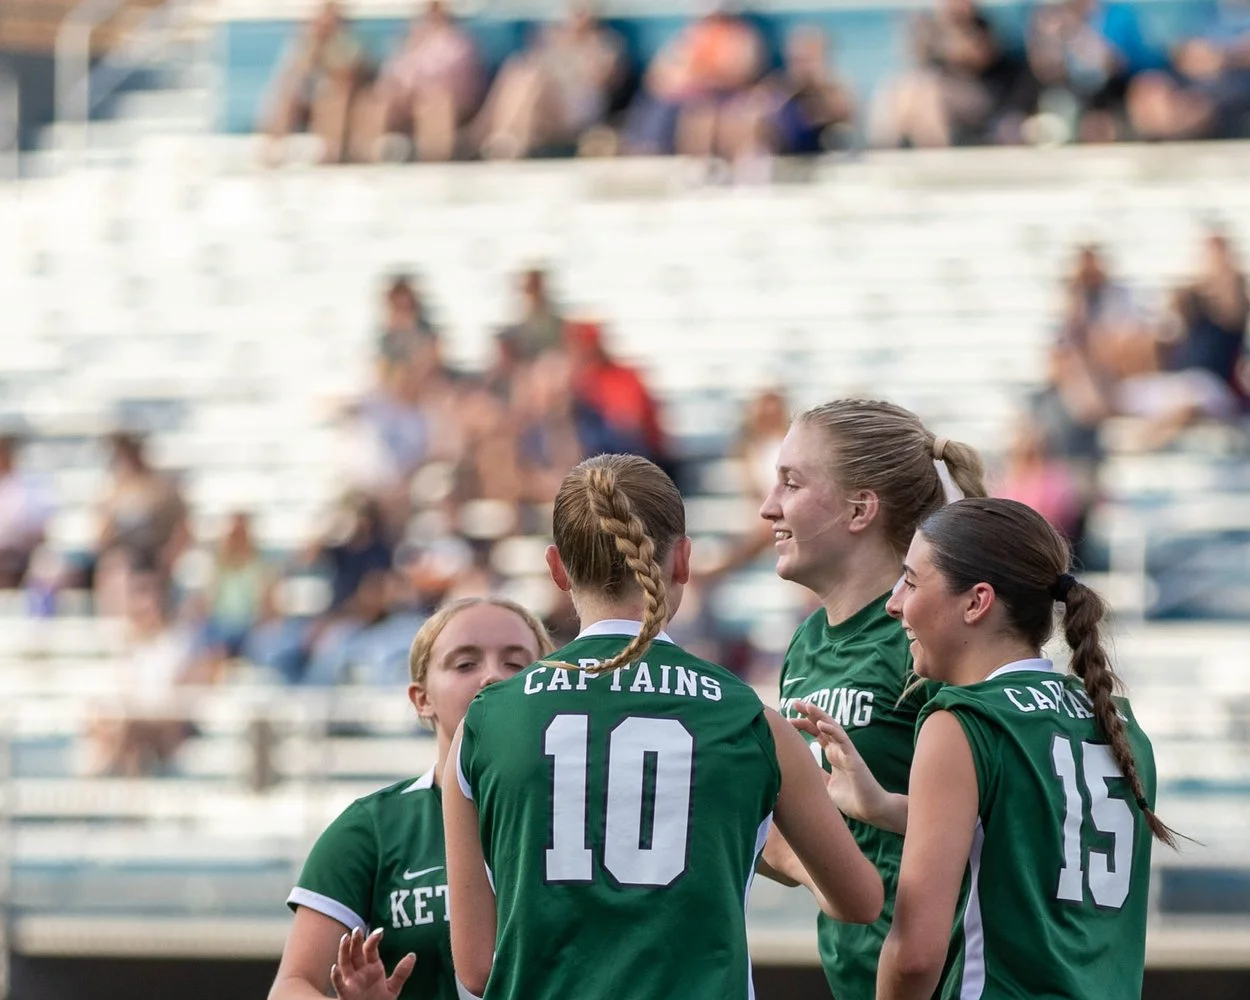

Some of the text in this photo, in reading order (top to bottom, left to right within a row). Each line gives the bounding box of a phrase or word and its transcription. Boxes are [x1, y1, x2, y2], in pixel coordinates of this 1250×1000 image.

[523, 658, 723, 702] CAPTAINS
[542, 712, 695, 887] 10
[1051, 734, 1136, 910] 15
